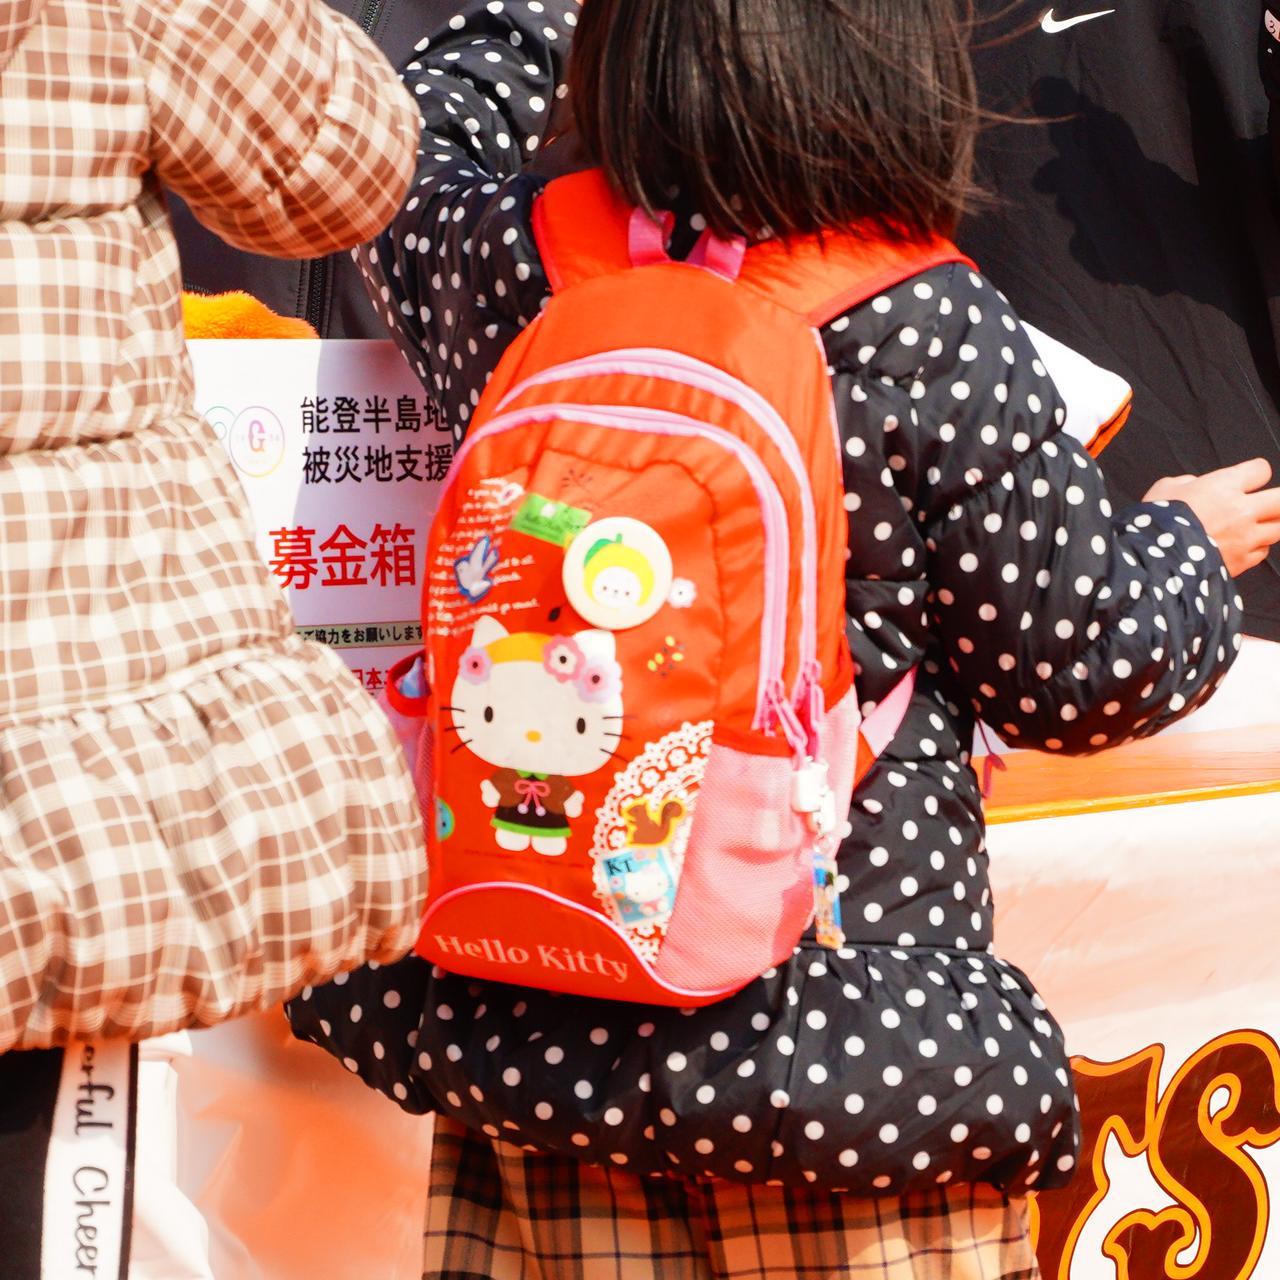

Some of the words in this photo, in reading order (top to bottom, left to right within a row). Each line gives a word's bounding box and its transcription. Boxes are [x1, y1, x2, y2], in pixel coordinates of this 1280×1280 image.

[302, 443, 453, 485] 被災地支援
[268, 523, 416, 590] 募金箱
[433, 934, 530, 965] Hello
[536, 944, 628, 984] Kitty
